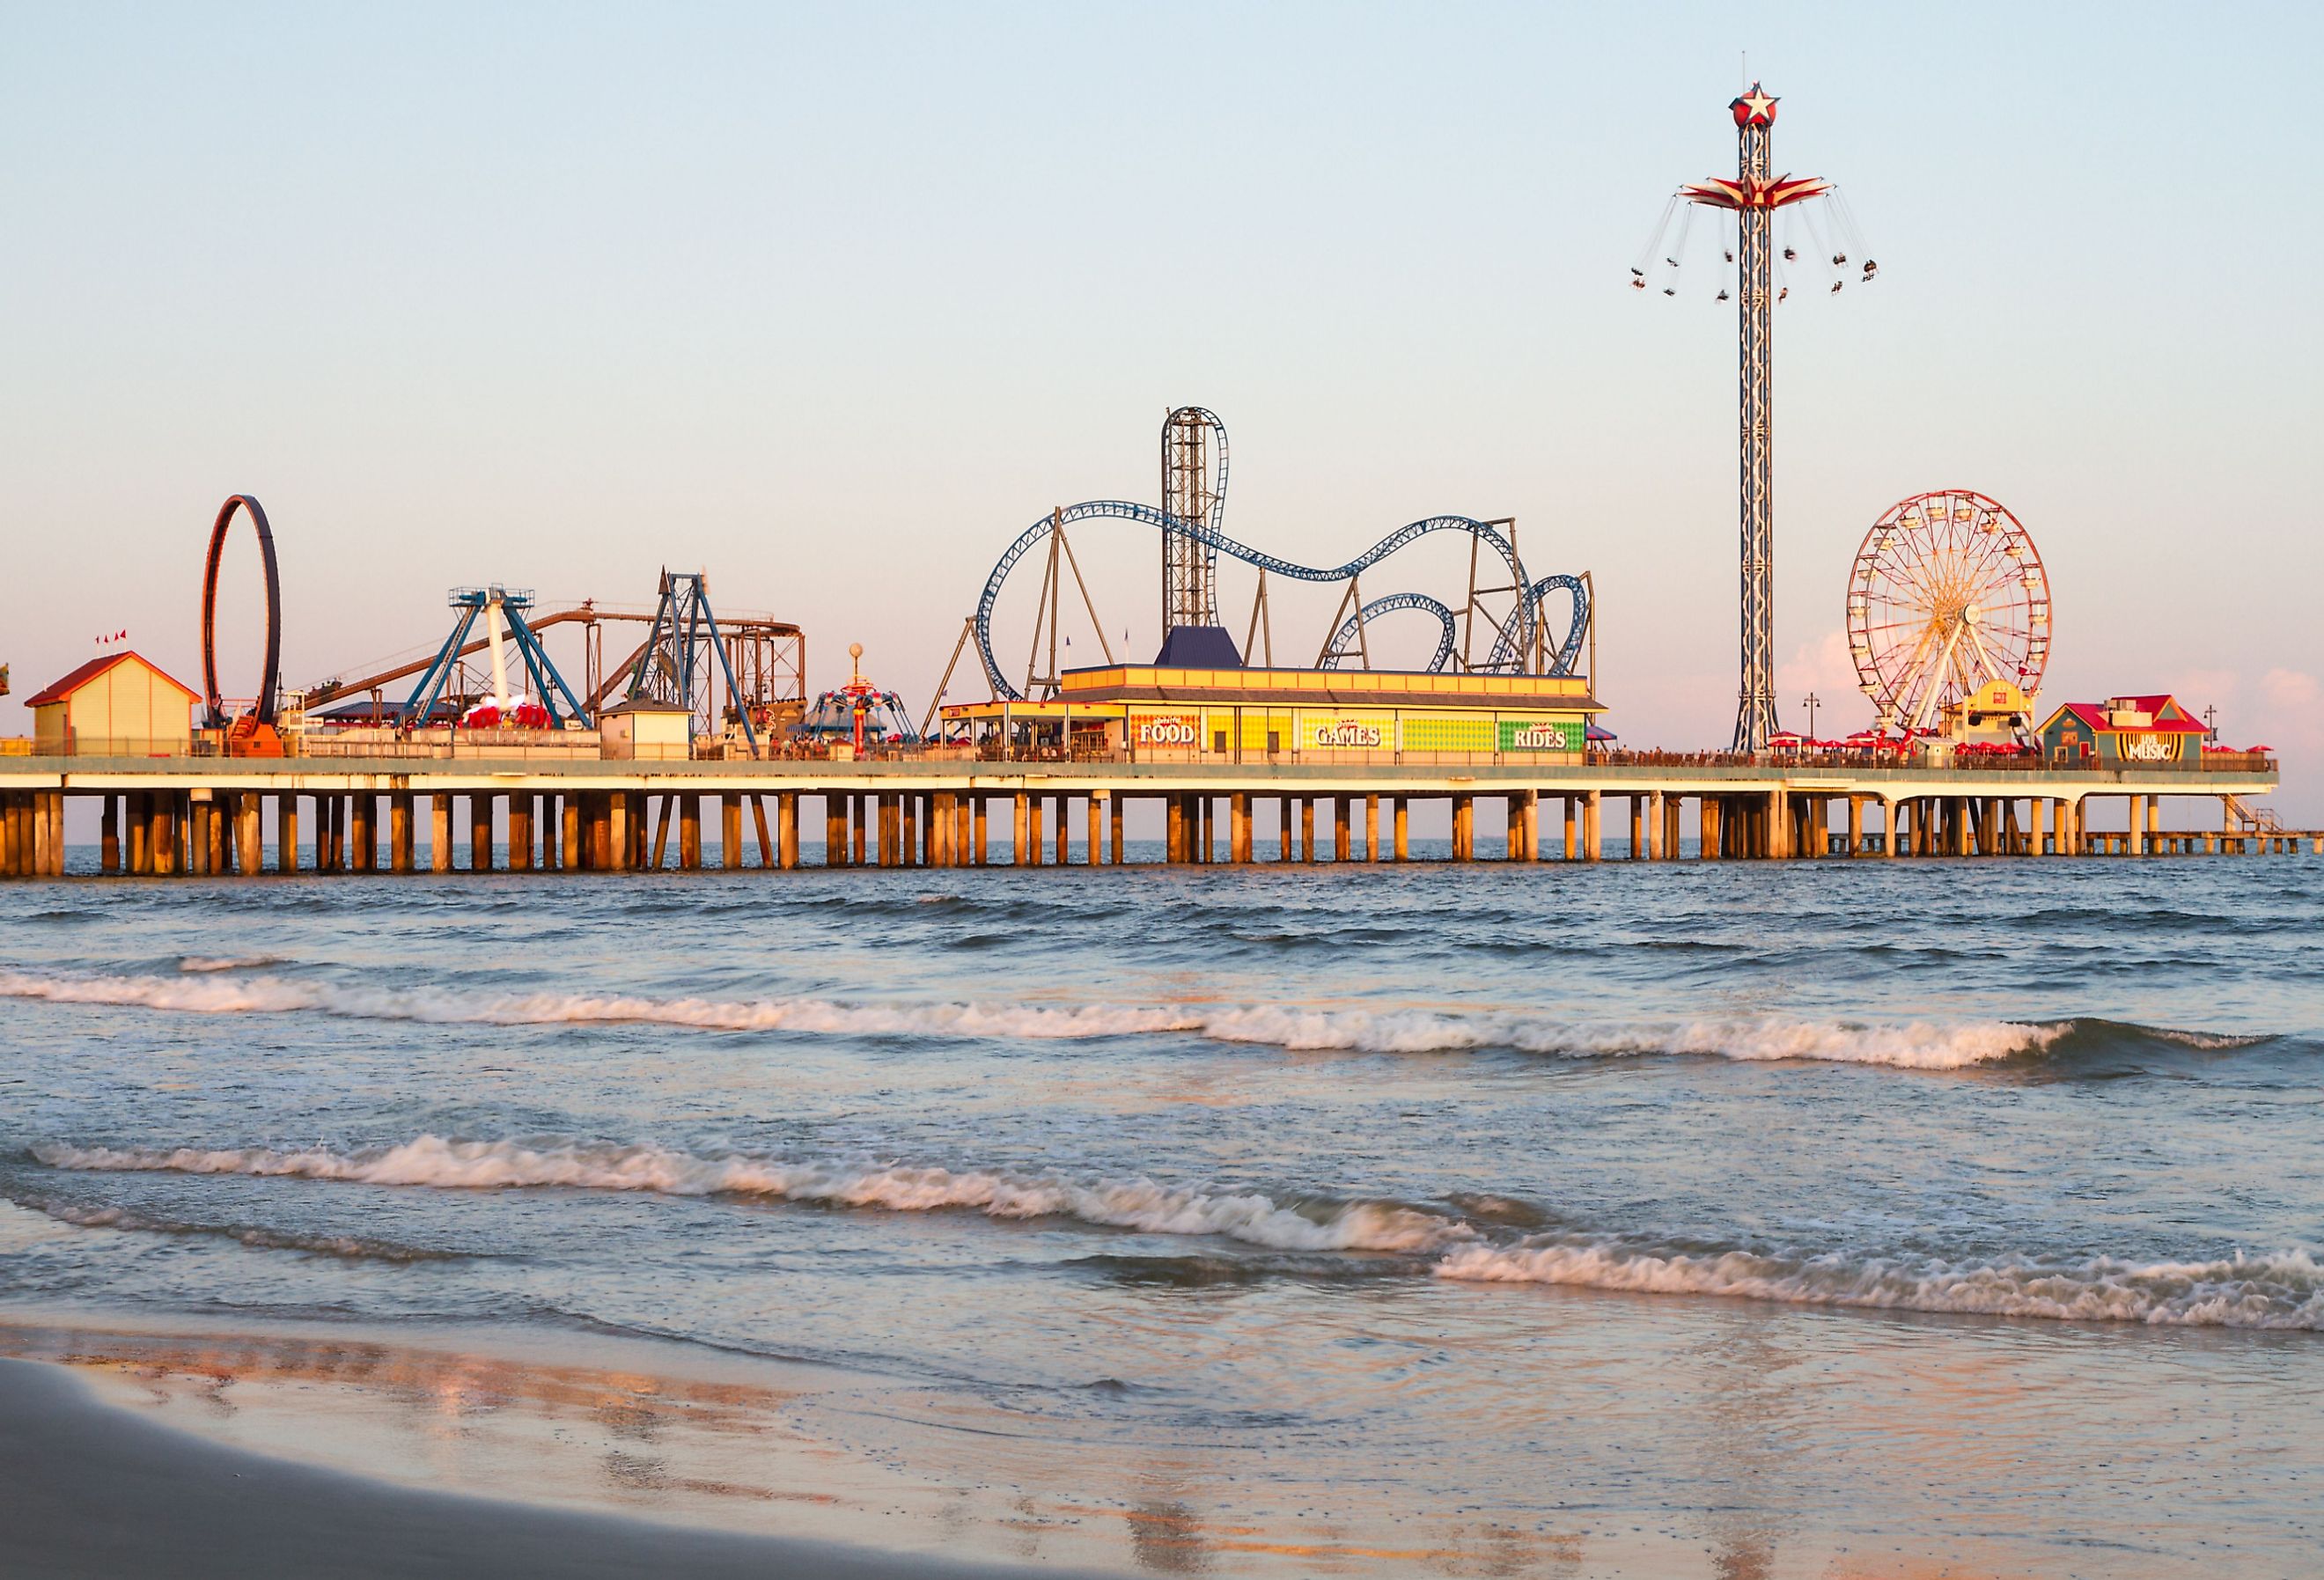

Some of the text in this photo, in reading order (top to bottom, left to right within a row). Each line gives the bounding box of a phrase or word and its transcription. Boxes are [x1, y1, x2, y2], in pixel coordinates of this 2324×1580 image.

[1141, 724, 1195, 743] FOOD
[1315, 726, 1380, 746] GAMES
[1515, 731, 1567, 748] RIDES
[2142, 734, 2158, 745] LIVE
[2129, 744, 2171, 760] MUSIC
